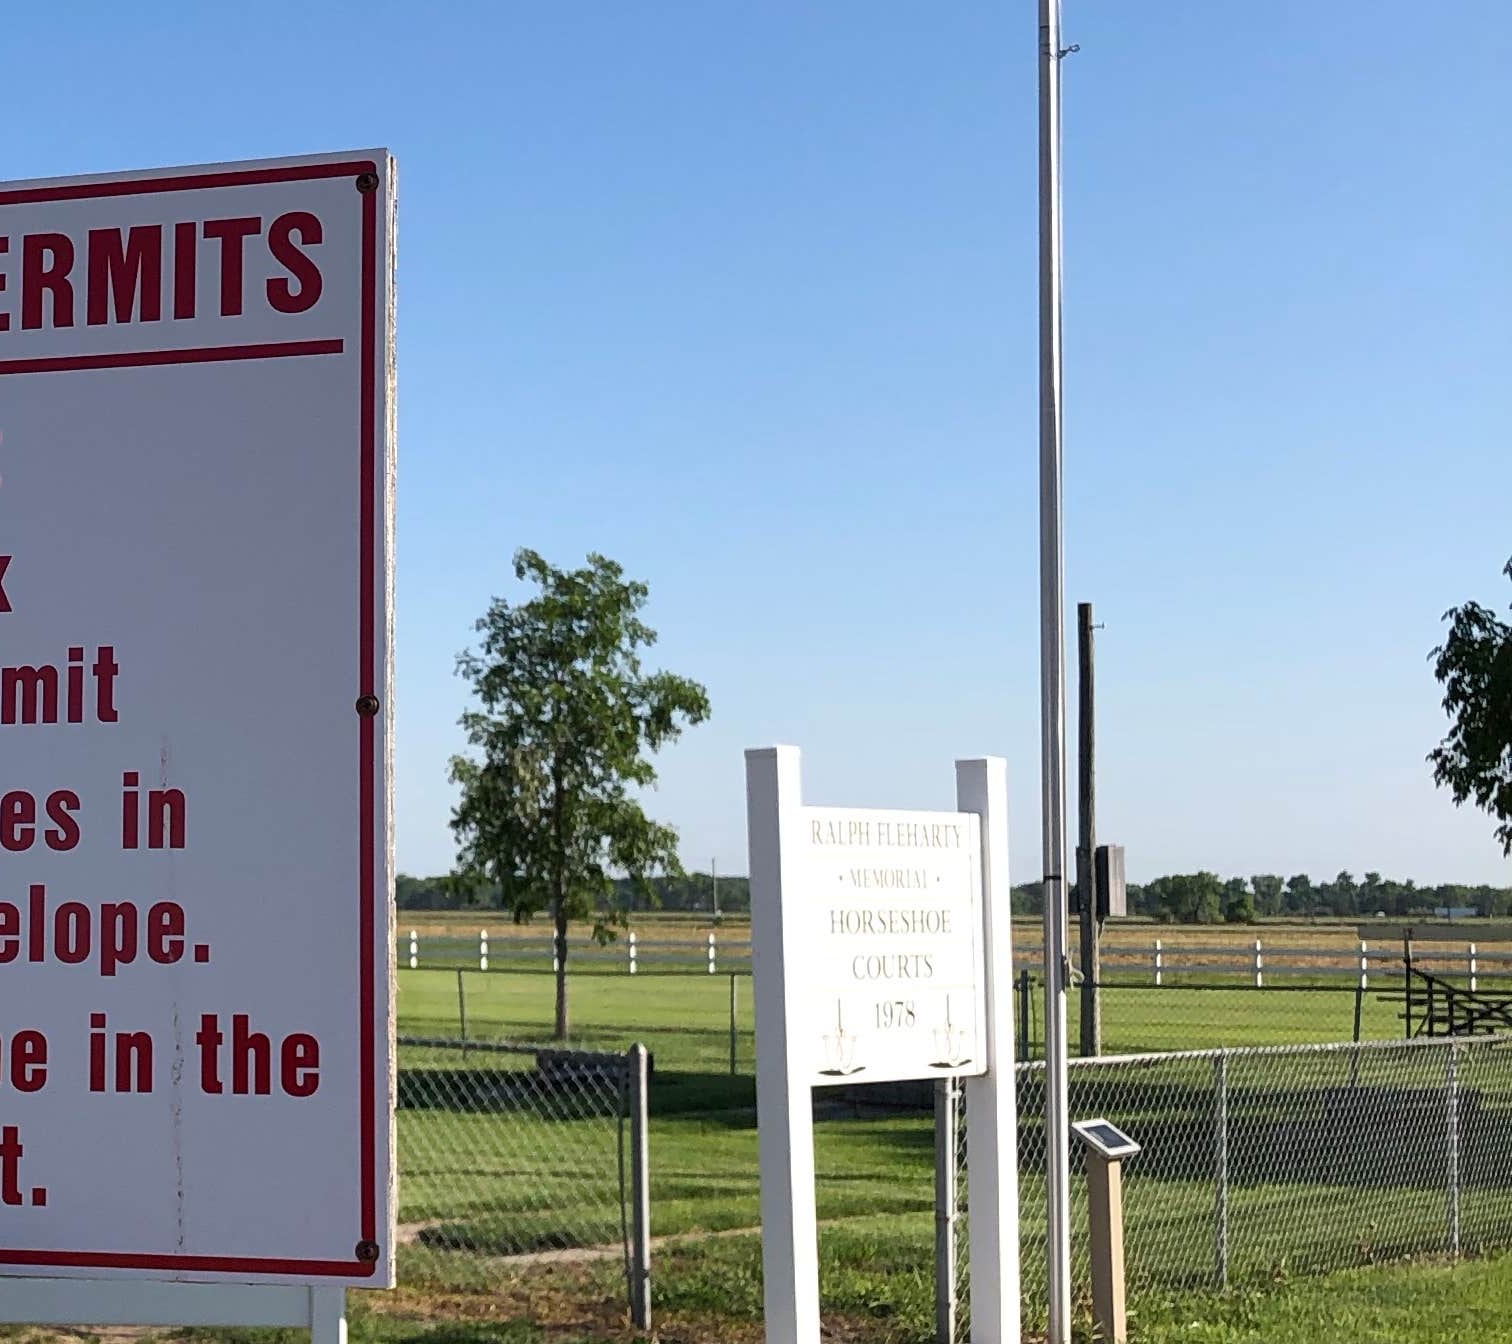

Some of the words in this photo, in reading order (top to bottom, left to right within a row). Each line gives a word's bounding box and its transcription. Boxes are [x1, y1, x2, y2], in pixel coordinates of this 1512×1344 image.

[123, 772, 185, 848] in
[811, 820, 871, 846] RALPH
[877, 822, 962, 848] FLEHARTY
[849, 868, 927, 889] MEMORIAL
[830, 909, 952, 934] HORSESHOE
[852, 954, 933, 980] COURTS
[875, 1001, 916, 1028] 1978
[89, 1013, 153, 1092] in
[195, 1014, 319, 1096] the
